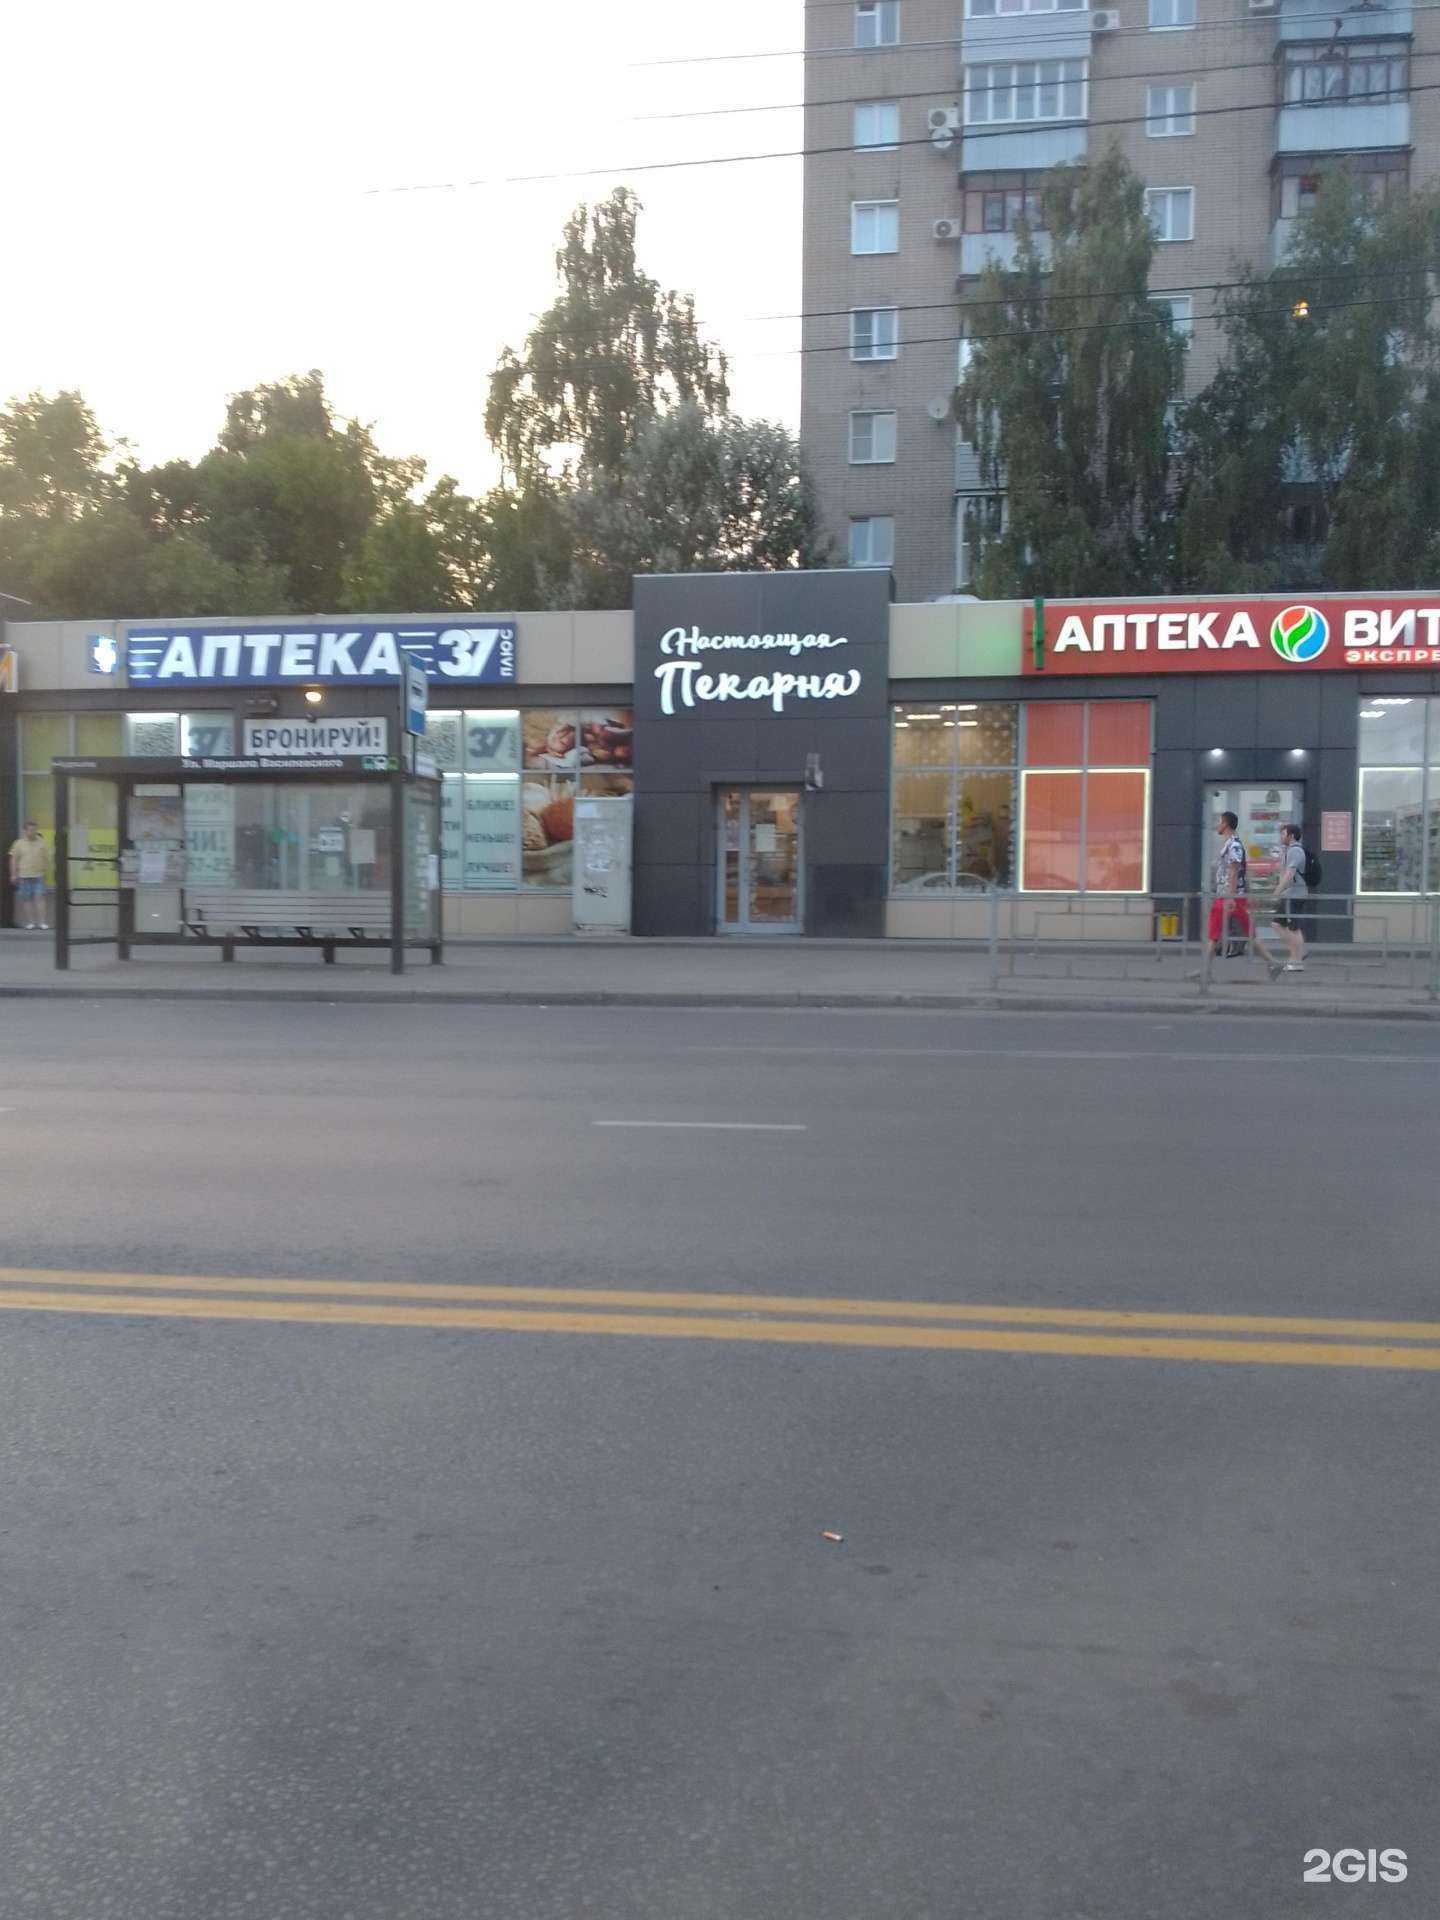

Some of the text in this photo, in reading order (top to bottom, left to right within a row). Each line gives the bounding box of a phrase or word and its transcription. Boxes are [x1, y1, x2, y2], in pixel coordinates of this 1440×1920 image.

[660, 626, 848, 656] Настоящая
[1053, 608, 1440, 652] АПТЕКА ВИТ
[156, 629, 500, 678] АПТЕКА 37
[500, 629, 514, 677] ПЛЮС
[654, 660, 861, 715] Пекарня
[251, 721, 381, 748] БРОНИРУЙ!
[468, 727, 507, 758] 37
